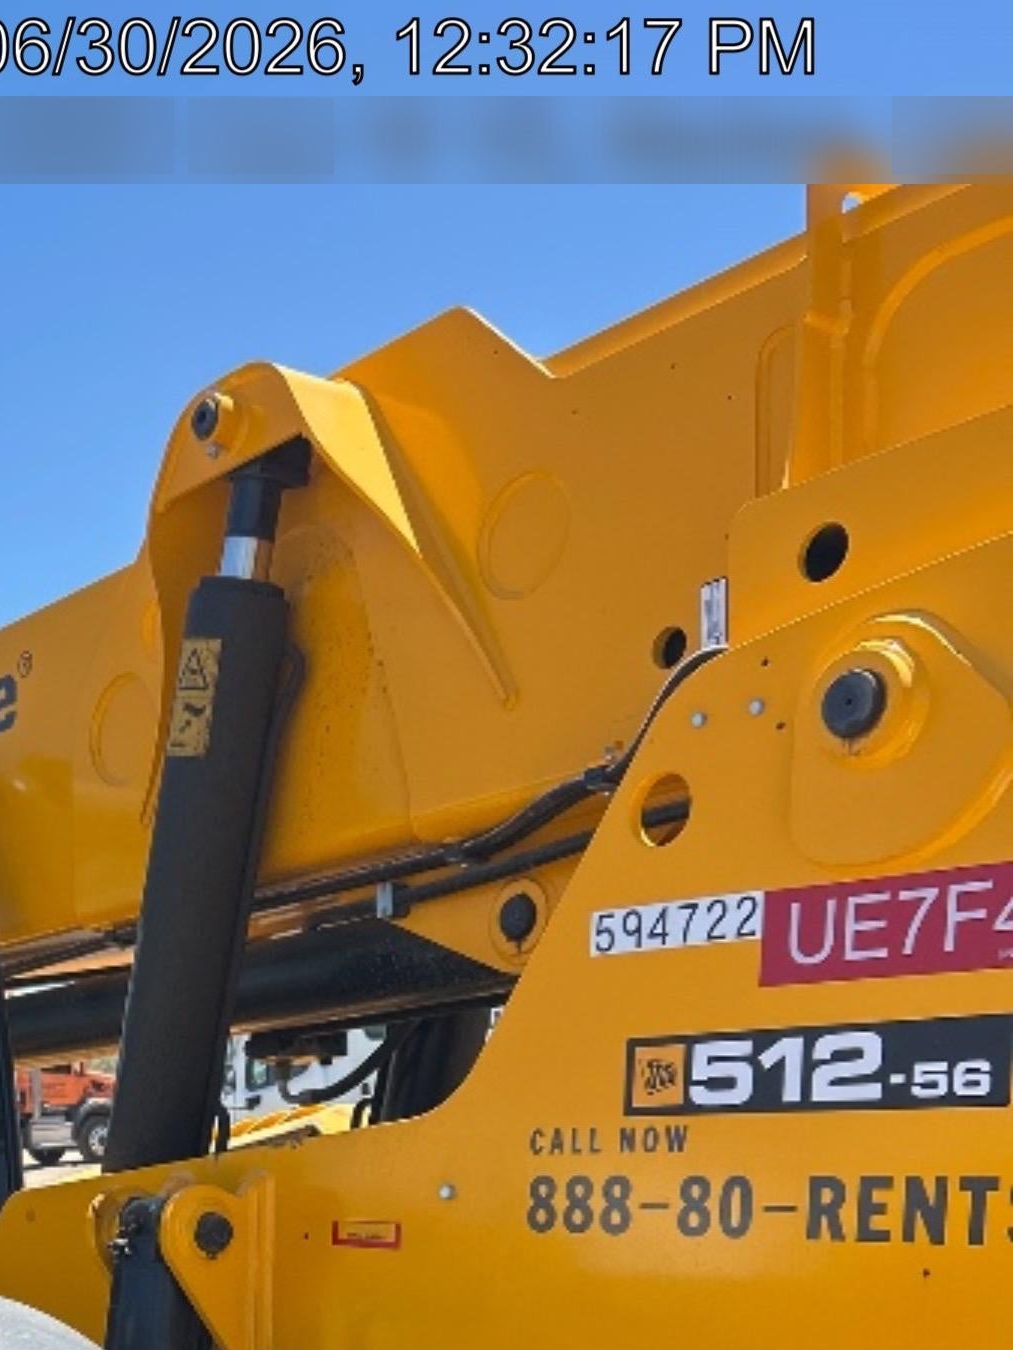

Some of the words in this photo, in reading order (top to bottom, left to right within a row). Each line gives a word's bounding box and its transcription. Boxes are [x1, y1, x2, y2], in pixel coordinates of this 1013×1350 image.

[594, 896, 759, 954] 594722
[529, 1127, 603, 1156] CALL
[619, 1124, 688, 1154] NOW
[526, 1174, 1013, 1246] 888-80-RENT
